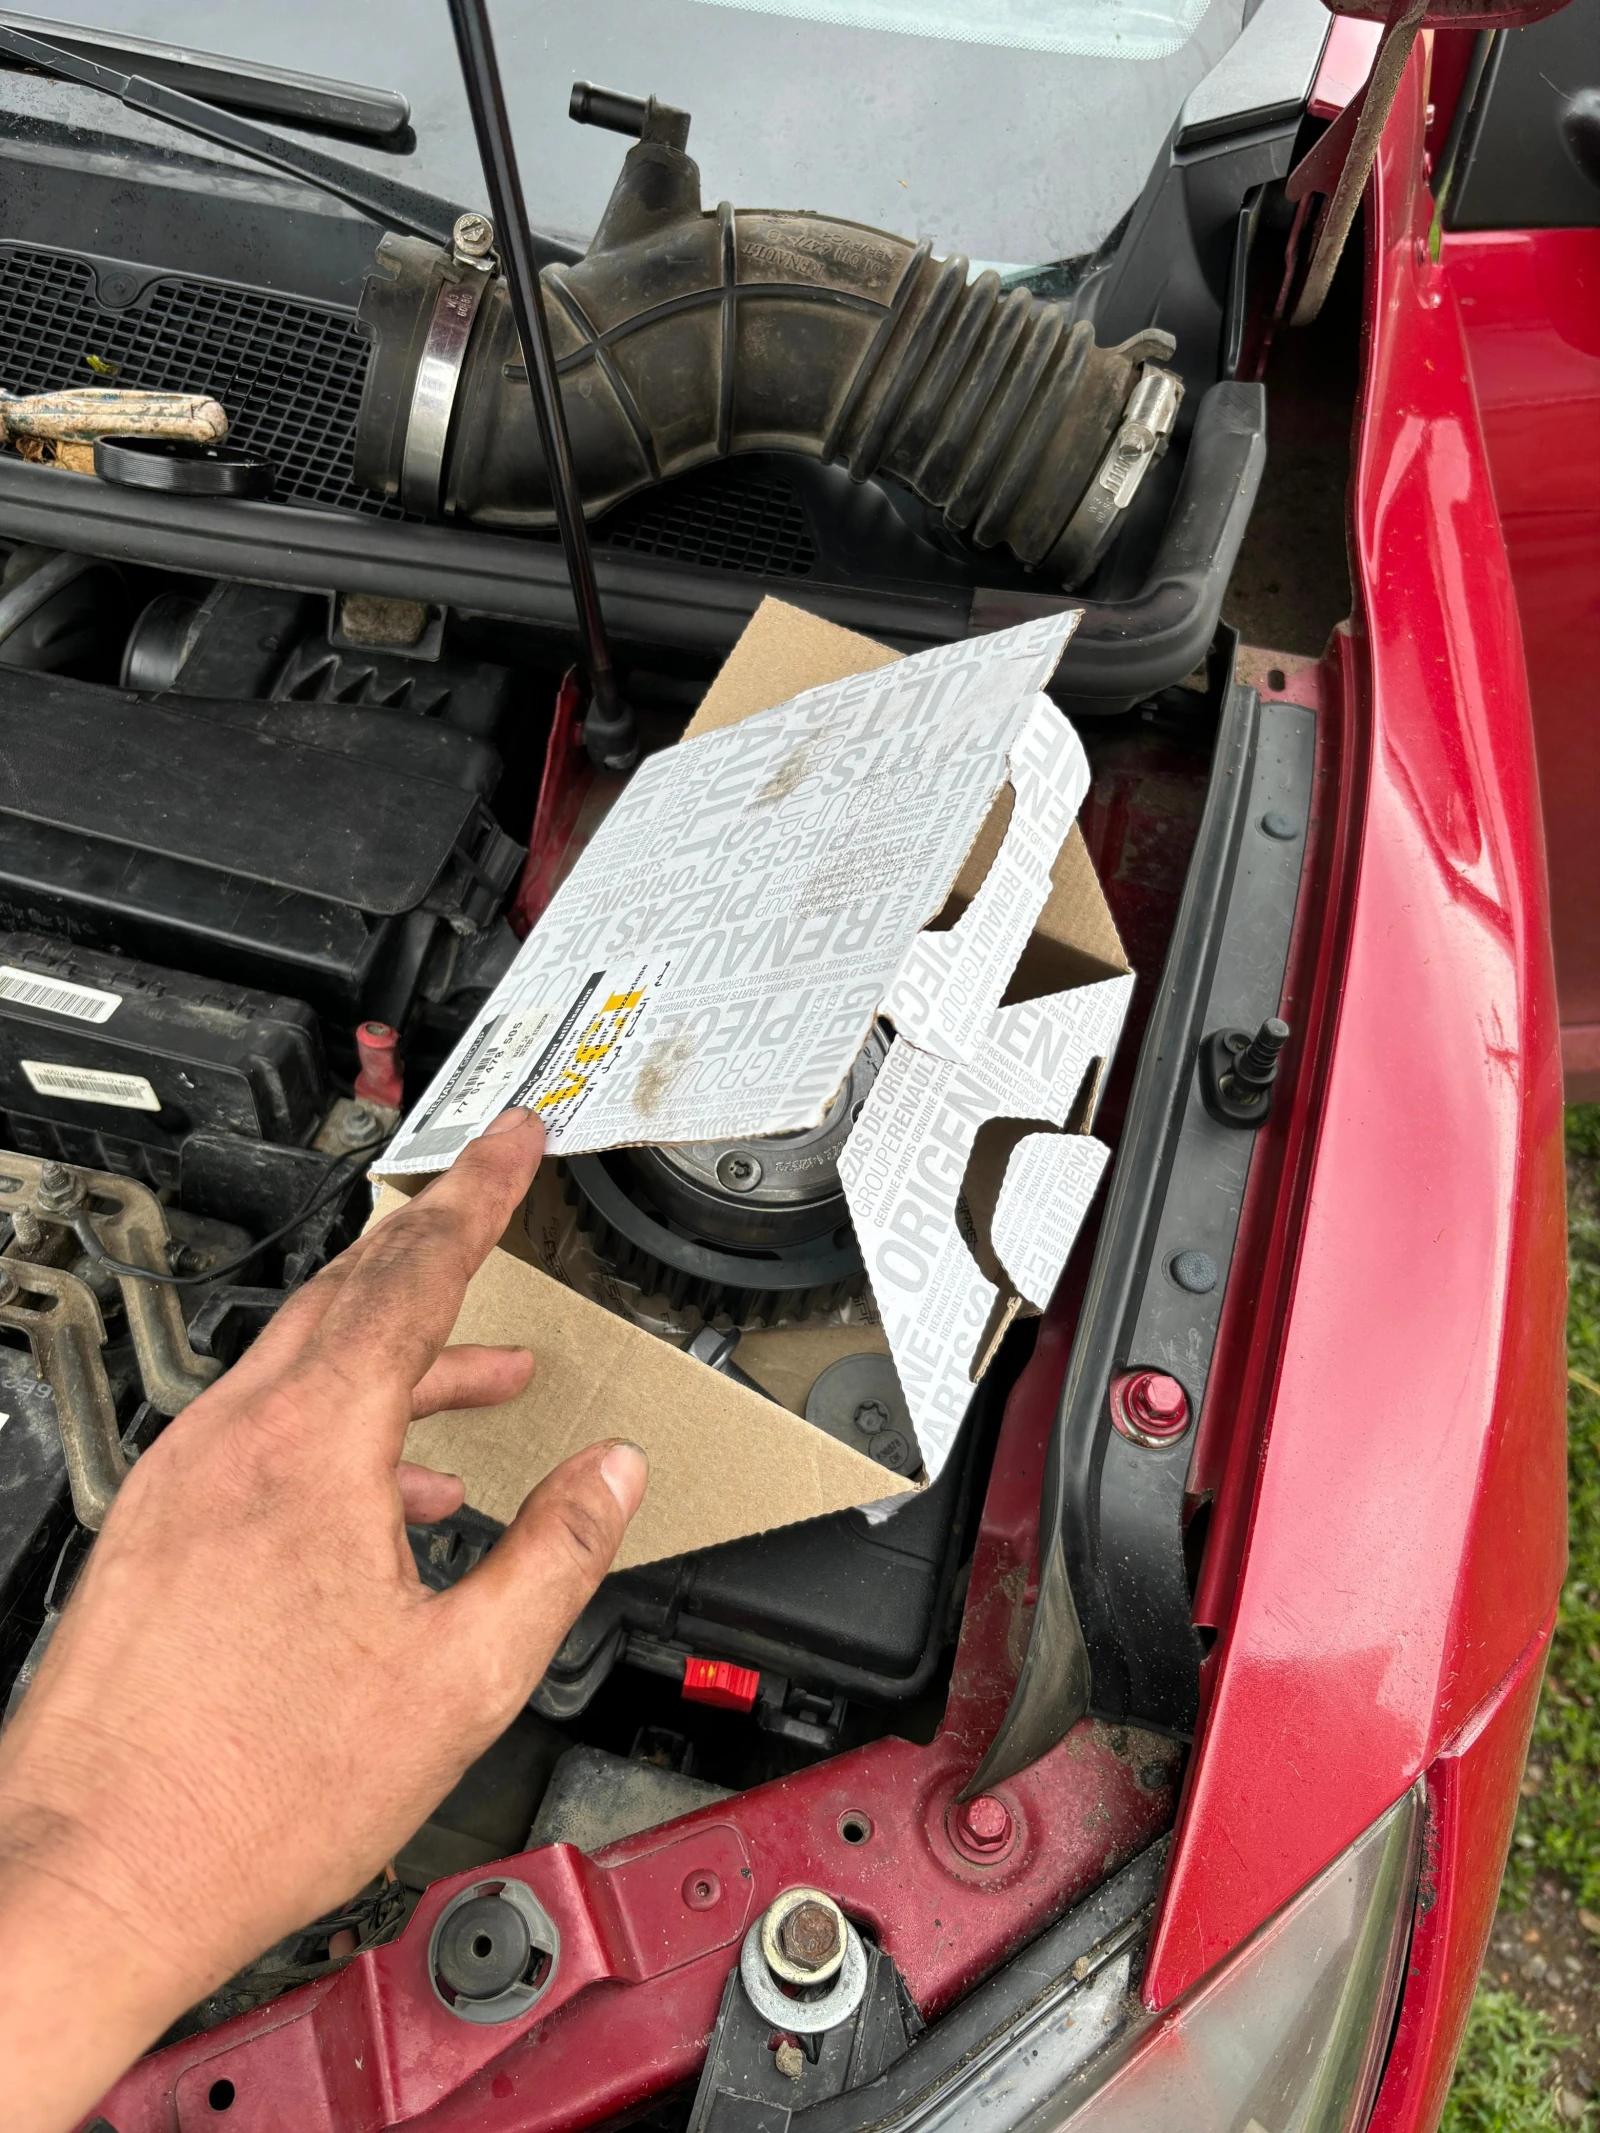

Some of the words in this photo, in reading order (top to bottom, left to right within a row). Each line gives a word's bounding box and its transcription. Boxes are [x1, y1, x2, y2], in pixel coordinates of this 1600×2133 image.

[671, 732, 717, 787] ORIGEN
[640, 759, 724, 859] PARTS
[658, 703, 800, 867] AULT
[896, 797, 938, 815] GENUINE
[884, 821, 926, 838] GENUINE
[889, 809, 932, 826] GENUINE
[907, 792, 964, 877] GENUINE
[734, 819, 858, 875] PIECES
[560, 872, 619, 898] GENUINE
[619, 858, 665, 882] PARTS
[578, 857, 727, 918] D'ORIGINE
[765, 884, 794, 896] PARTS
[608, 875, 769, 950] PIEZAS
[874, 881, 920, 946] PARTS
[1007, 887, 1034, 933] GENUINE
[543, 916, 611, 968] DE
[939, 868, 1023, 1032] RENAULTGROUP
[992, 928, 1014, 966] PARTS
[762, 978, 804, 994] GENUINE
[806, 968, 858, 986] D'ORIGINE
[860, 959, 898, 975] PIECES
[971, 963, 997, 1010] GENUINE
[653, 999, 696, 1014] D'ORIGINE
[696, 992, 730, 1006] PIECES
[730, 987, 761, 1000] PARTS
[1077, 998, 1097, 1033] PIEZAS
[539, 1043, 559, 1070] avant
[559, 989, 592, 1039] utilisation
[576, 1013, 598, 1043] öffnen
[954, 1008, 977, 1047] PARTS
[1087, 1006, 1107, 1041] PIEZAS
[1097, 1014, 1116, 1048] PIEZAS
[427, 1069, 460, 1114] RENAULT
[457, 1032, 484, 1067] GROUP
[453, 1101, 467, 1115] 77
[470, 1082, 485, 1094] 01
[486, 1051, 504, 1073] 478
[503, 1022, 522, 1044] 505
[539, 992, 640, 1108] VCI
[539, 1050, 566, 1080] before
[566, 1030, 578, 1046] use
[550, 1074, 571, 1098] antes
[572, 1058, 581, 1070] de
[581, 1018, 605, 1054] utilizar
[559, 1092, 577, 1114] voor
[578, 1052, 607, 1089] gebruik
[607, 1011, 631, 1048] openen
[547, 1086, 572, 1116] aprire
[573, 1054, 595, 1082] prima
[868, 1103, 888, 1133] DE
[874, 1174, 900, 1228] GENUINE
[897, 1143, 918, 1179] PARTS
[914, 1098, 937, 1146] GENUINE
[932, 1062, 954, 1101] PARTS
[875, 1071, 1001, 1294] ORIGEN
